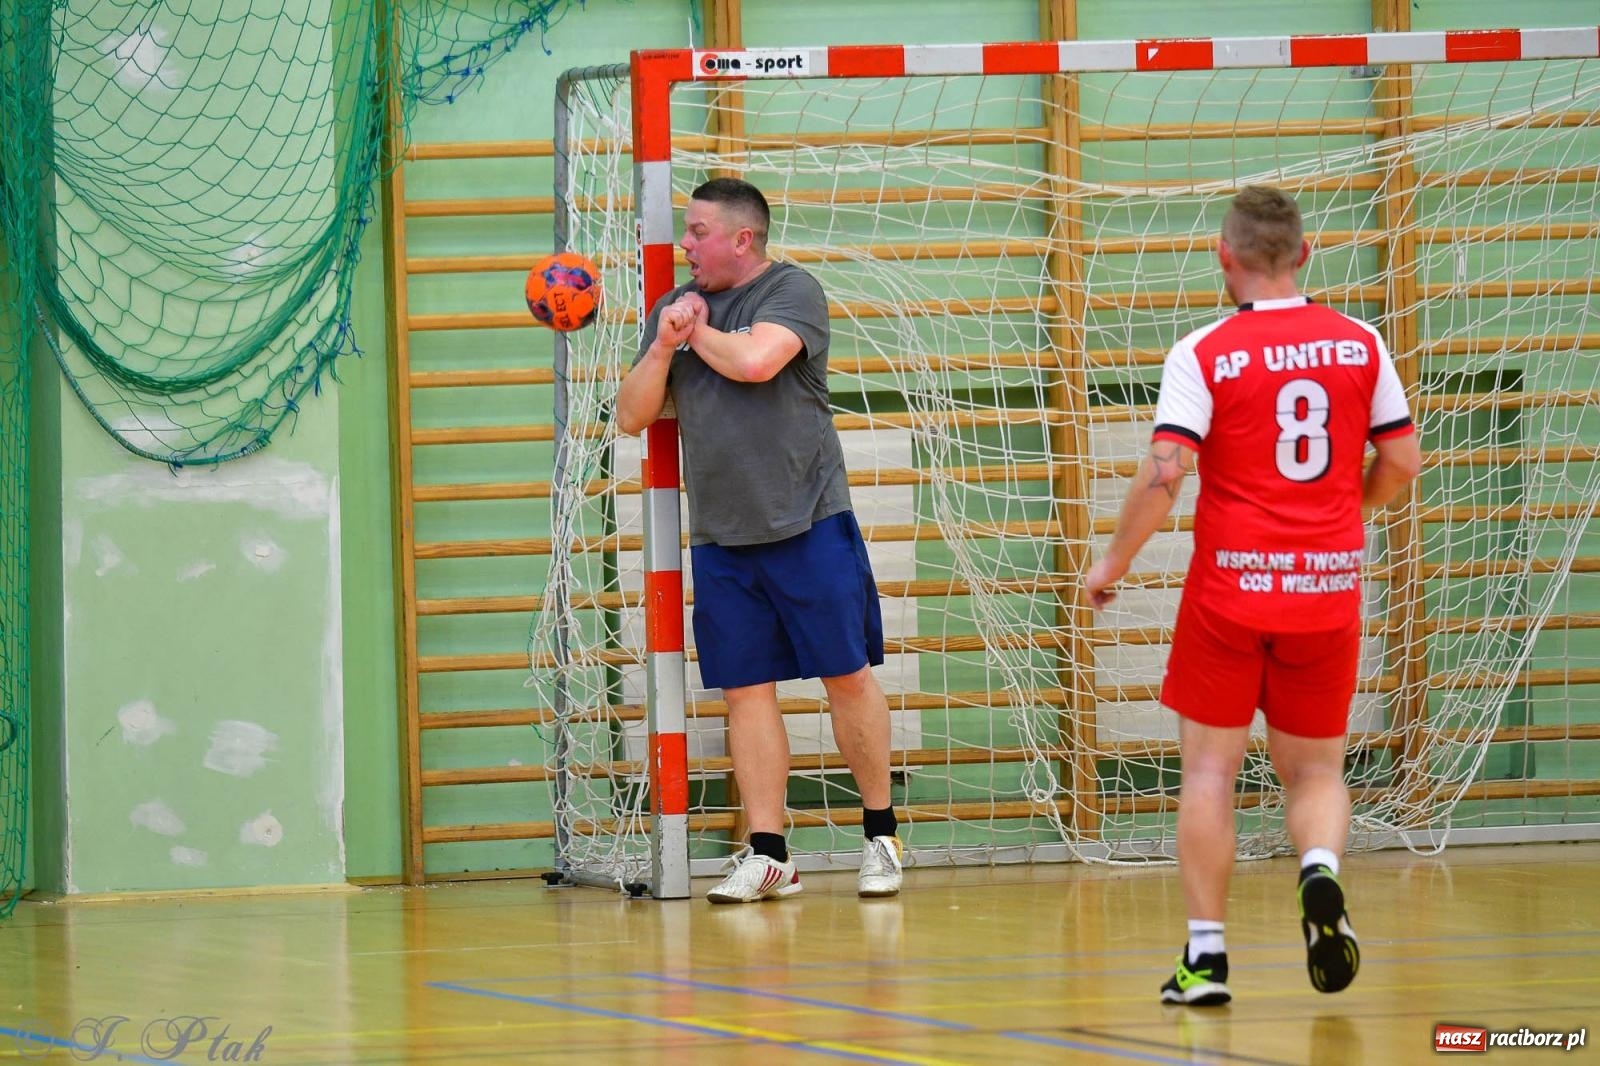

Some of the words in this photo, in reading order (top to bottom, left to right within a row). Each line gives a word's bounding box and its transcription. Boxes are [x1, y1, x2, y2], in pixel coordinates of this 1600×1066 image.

[756, 54, 803, 73] sport
[1213, 350, 1250, 383] AP
[1263, 339, 1369, 372] UNITED
[1275, 378, 1332, 483] 8
